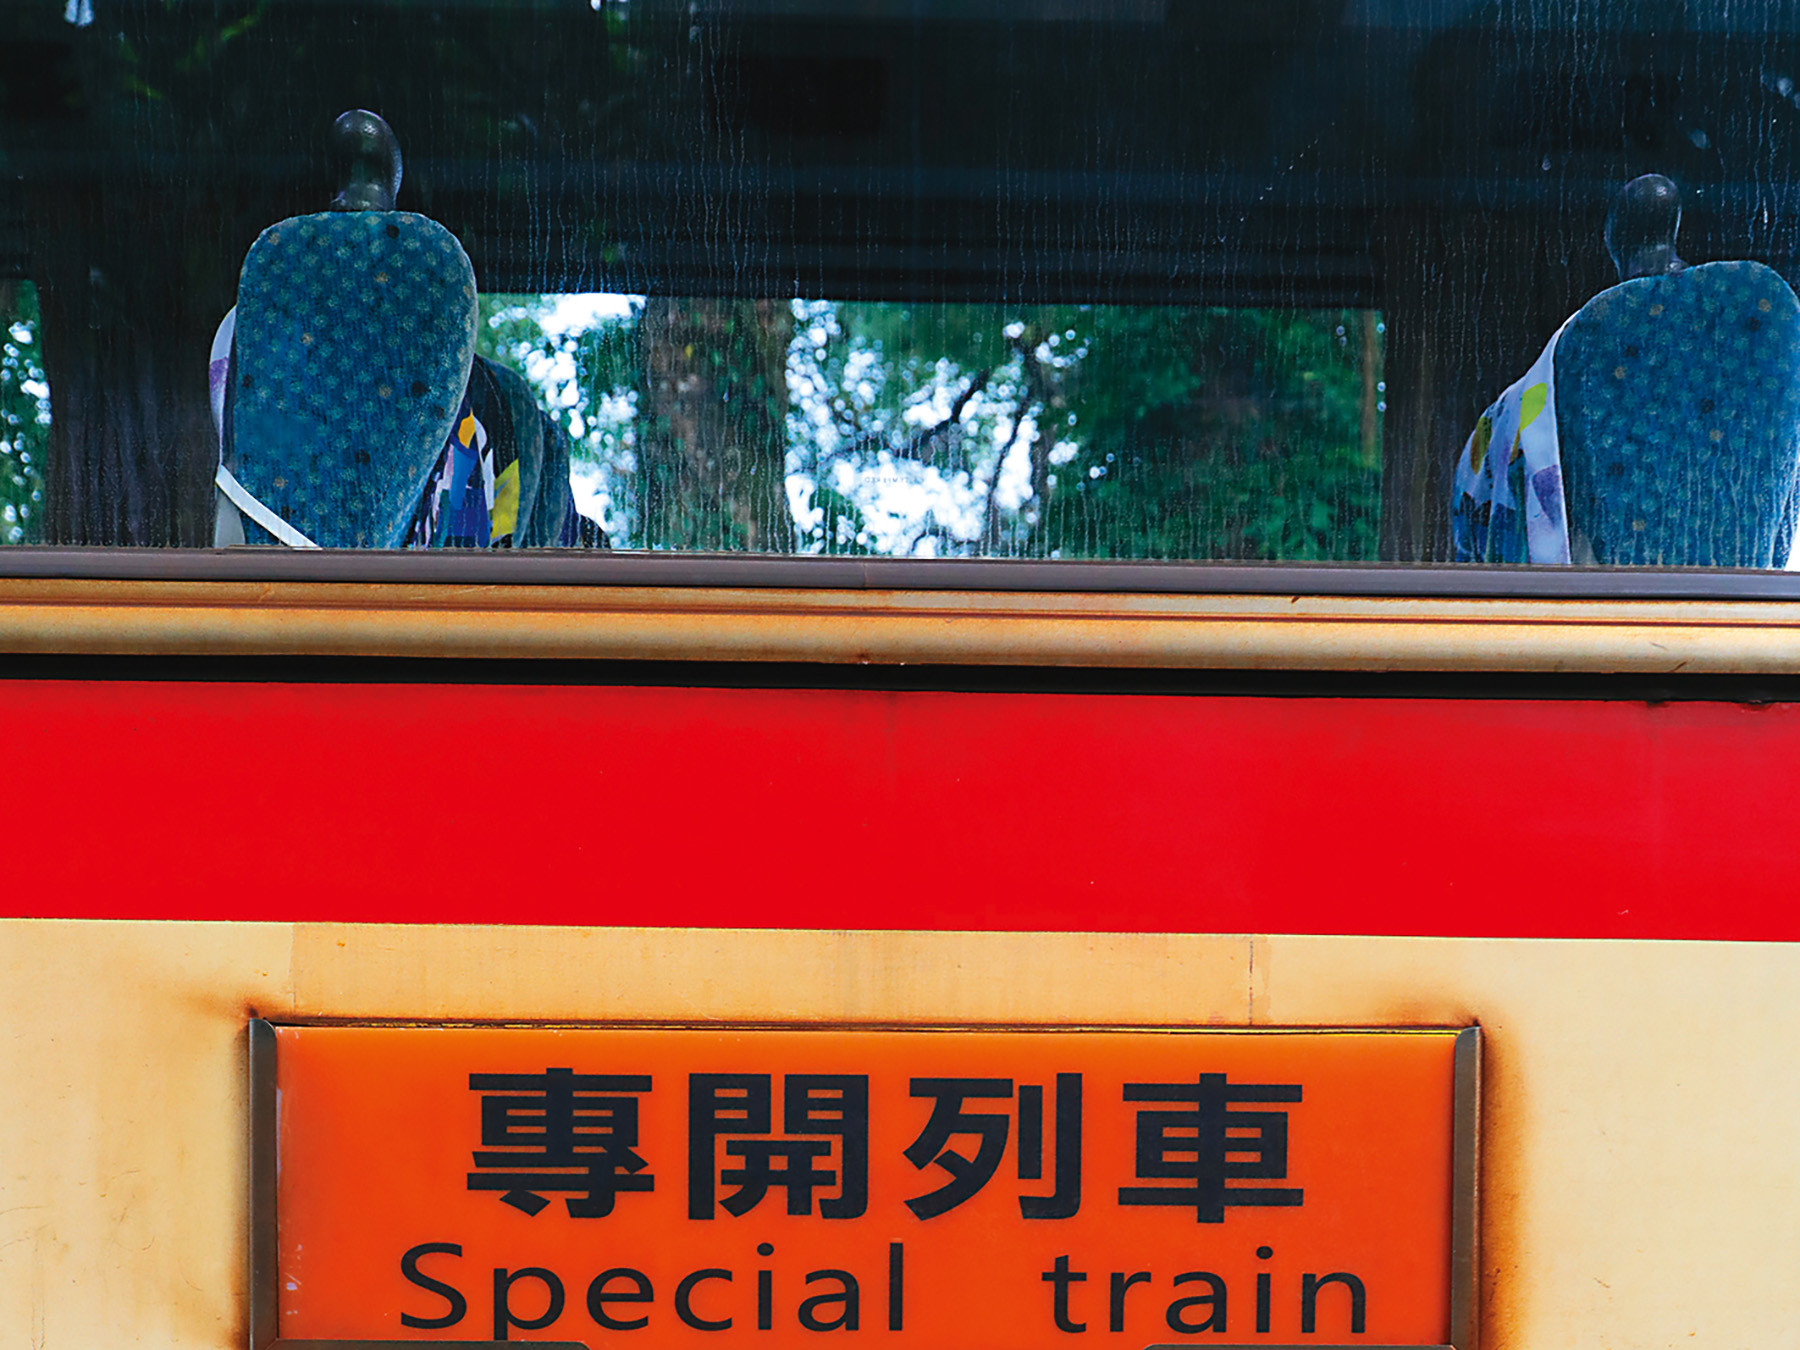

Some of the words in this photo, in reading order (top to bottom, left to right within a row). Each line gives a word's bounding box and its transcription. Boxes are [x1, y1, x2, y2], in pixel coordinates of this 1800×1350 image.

[467, 1068, 1304, 1223] 專開列車
[401, 1243, 903, 1342] Special
[1042, 1246, 1366, 1335] train
